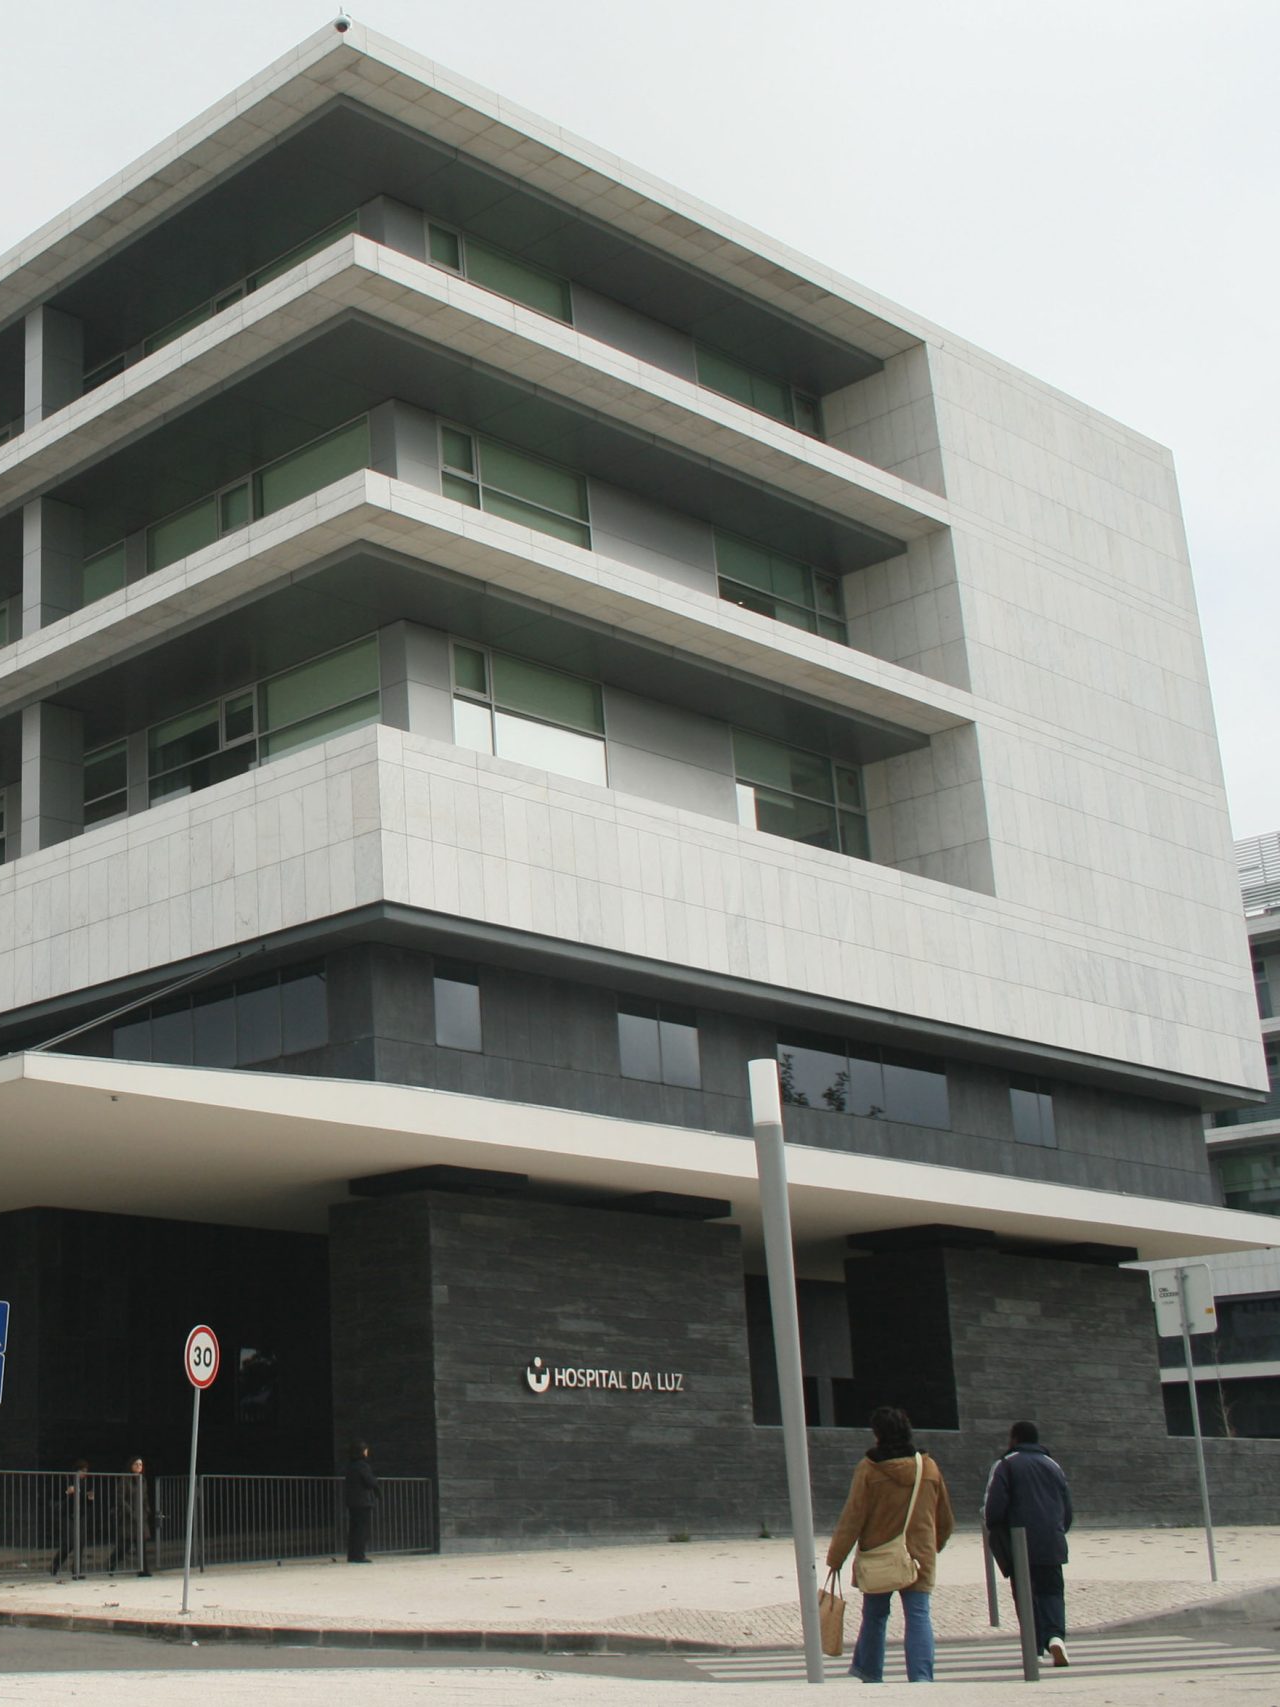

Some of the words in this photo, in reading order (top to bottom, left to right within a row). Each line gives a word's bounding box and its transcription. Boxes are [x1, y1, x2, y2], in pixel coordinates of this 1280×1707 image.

[193, 1346, 212, 1368] 30
[554, 1367, 627, 1389] HOSPITAL
[631, 1371, 653, 1391] DA
[657, 1372, 684, 1391] LUZ
